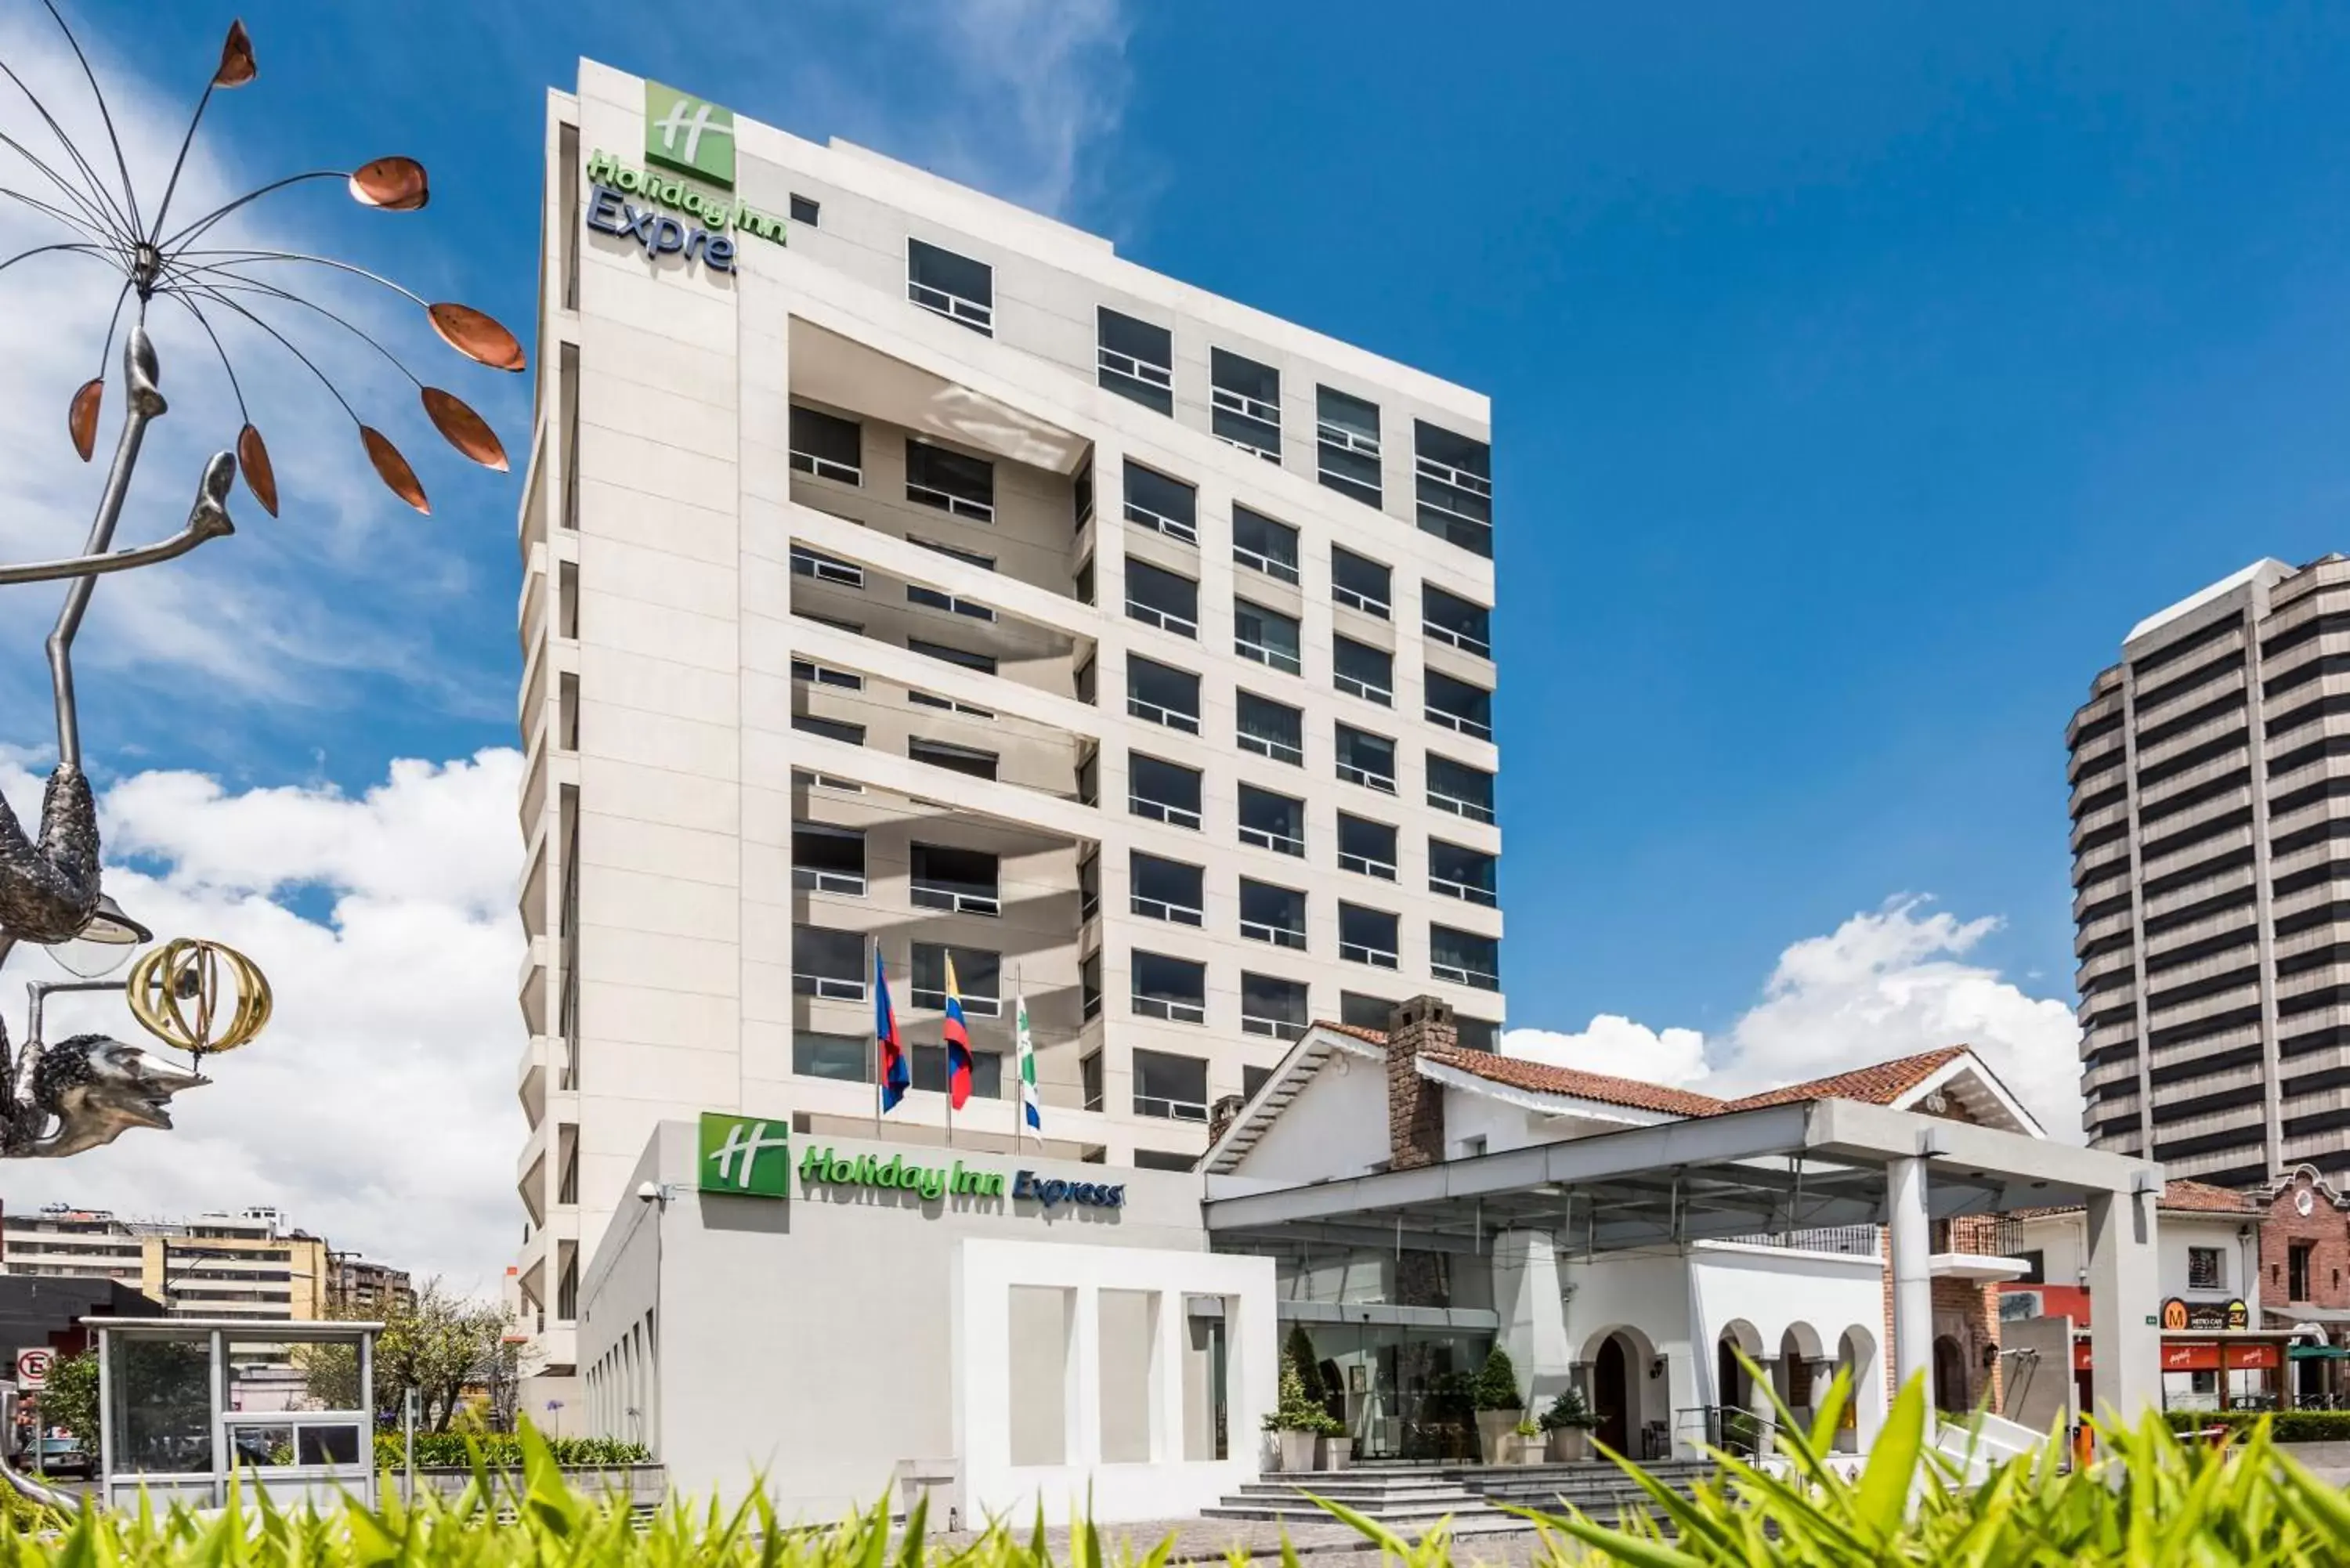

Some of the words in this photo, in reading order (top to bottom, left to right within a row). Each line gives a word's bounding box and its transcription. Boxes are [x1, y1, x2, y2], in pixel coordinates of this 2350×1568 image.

[586, 184, 737, 276] Expre
[588, 148, 728, 230] Holiday
[734, 199, 786, 247] Inn
[797, 1145, 945, 1199] Holiday
[949, 1160, 1005, 1196] Inn
[1012, 1169, 1125, 1208] Express
[30, 1357, 45, 1374] E
